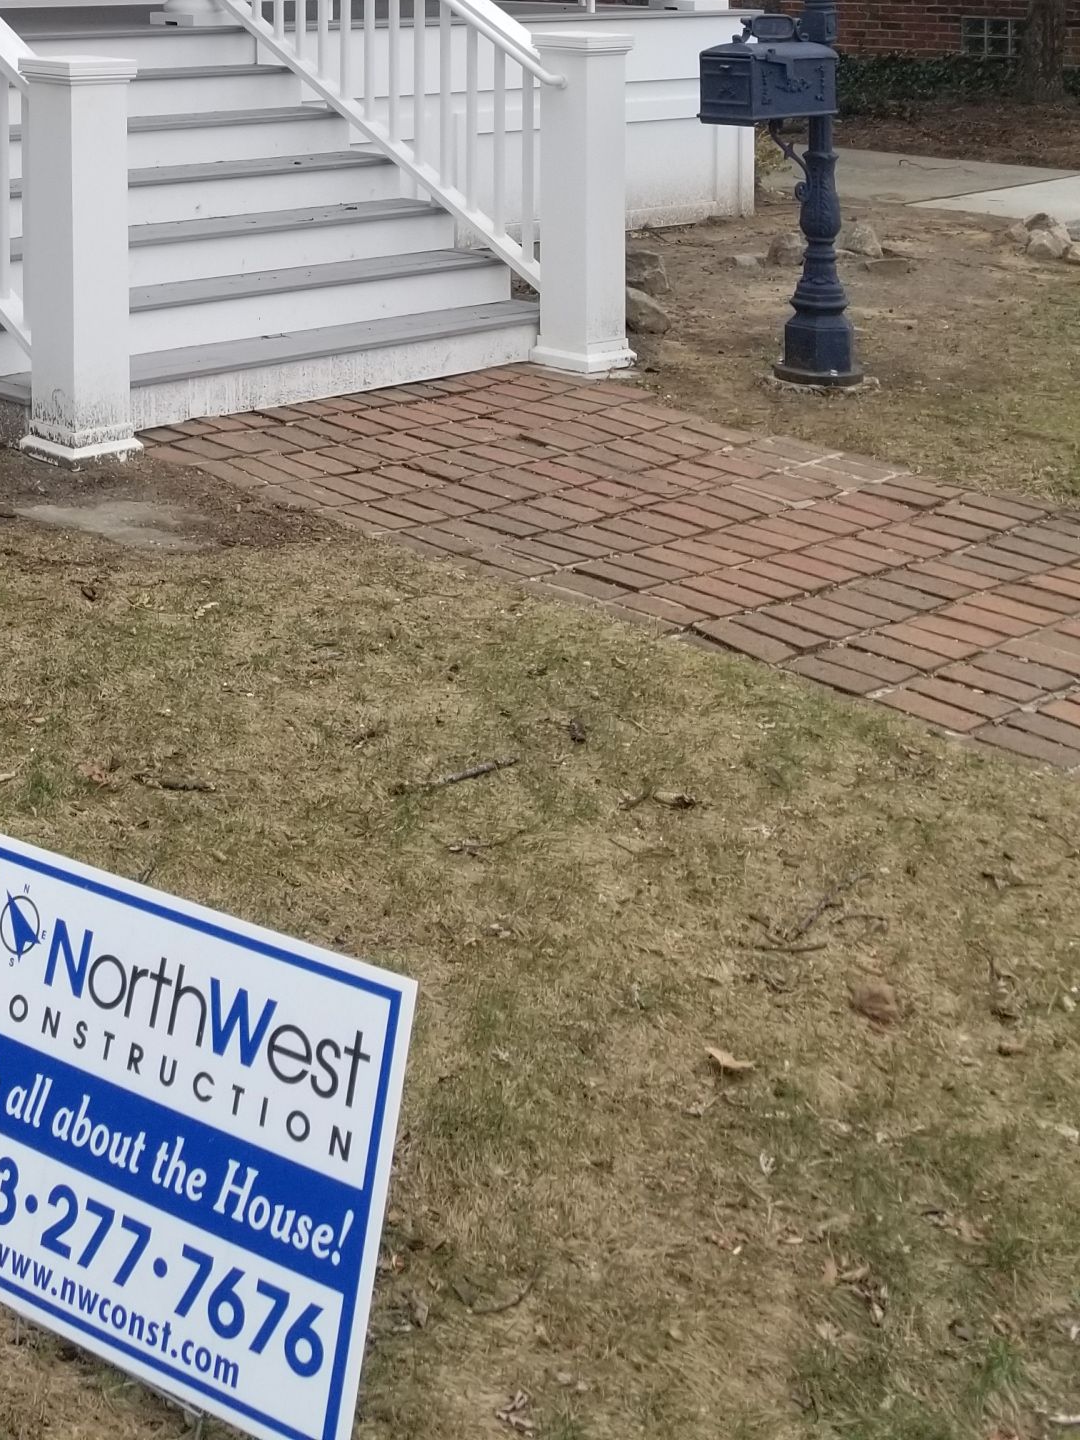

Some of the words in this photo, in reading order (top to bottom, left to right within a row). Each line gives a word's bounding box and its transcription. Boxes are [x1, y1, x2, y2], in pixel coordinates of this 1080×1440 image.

[23, 884, 30, 894] N
[41, 930, 47, 940] E
[8, 957, 15, 967] S
[44, 918, 371, 1107] NorthWest
[6, 1073, 53, 1128] all
[52, 1094, 146, 1173] about
[151, 1136, 207, 1201] the
[213, 1159, 354, 1266] House!
